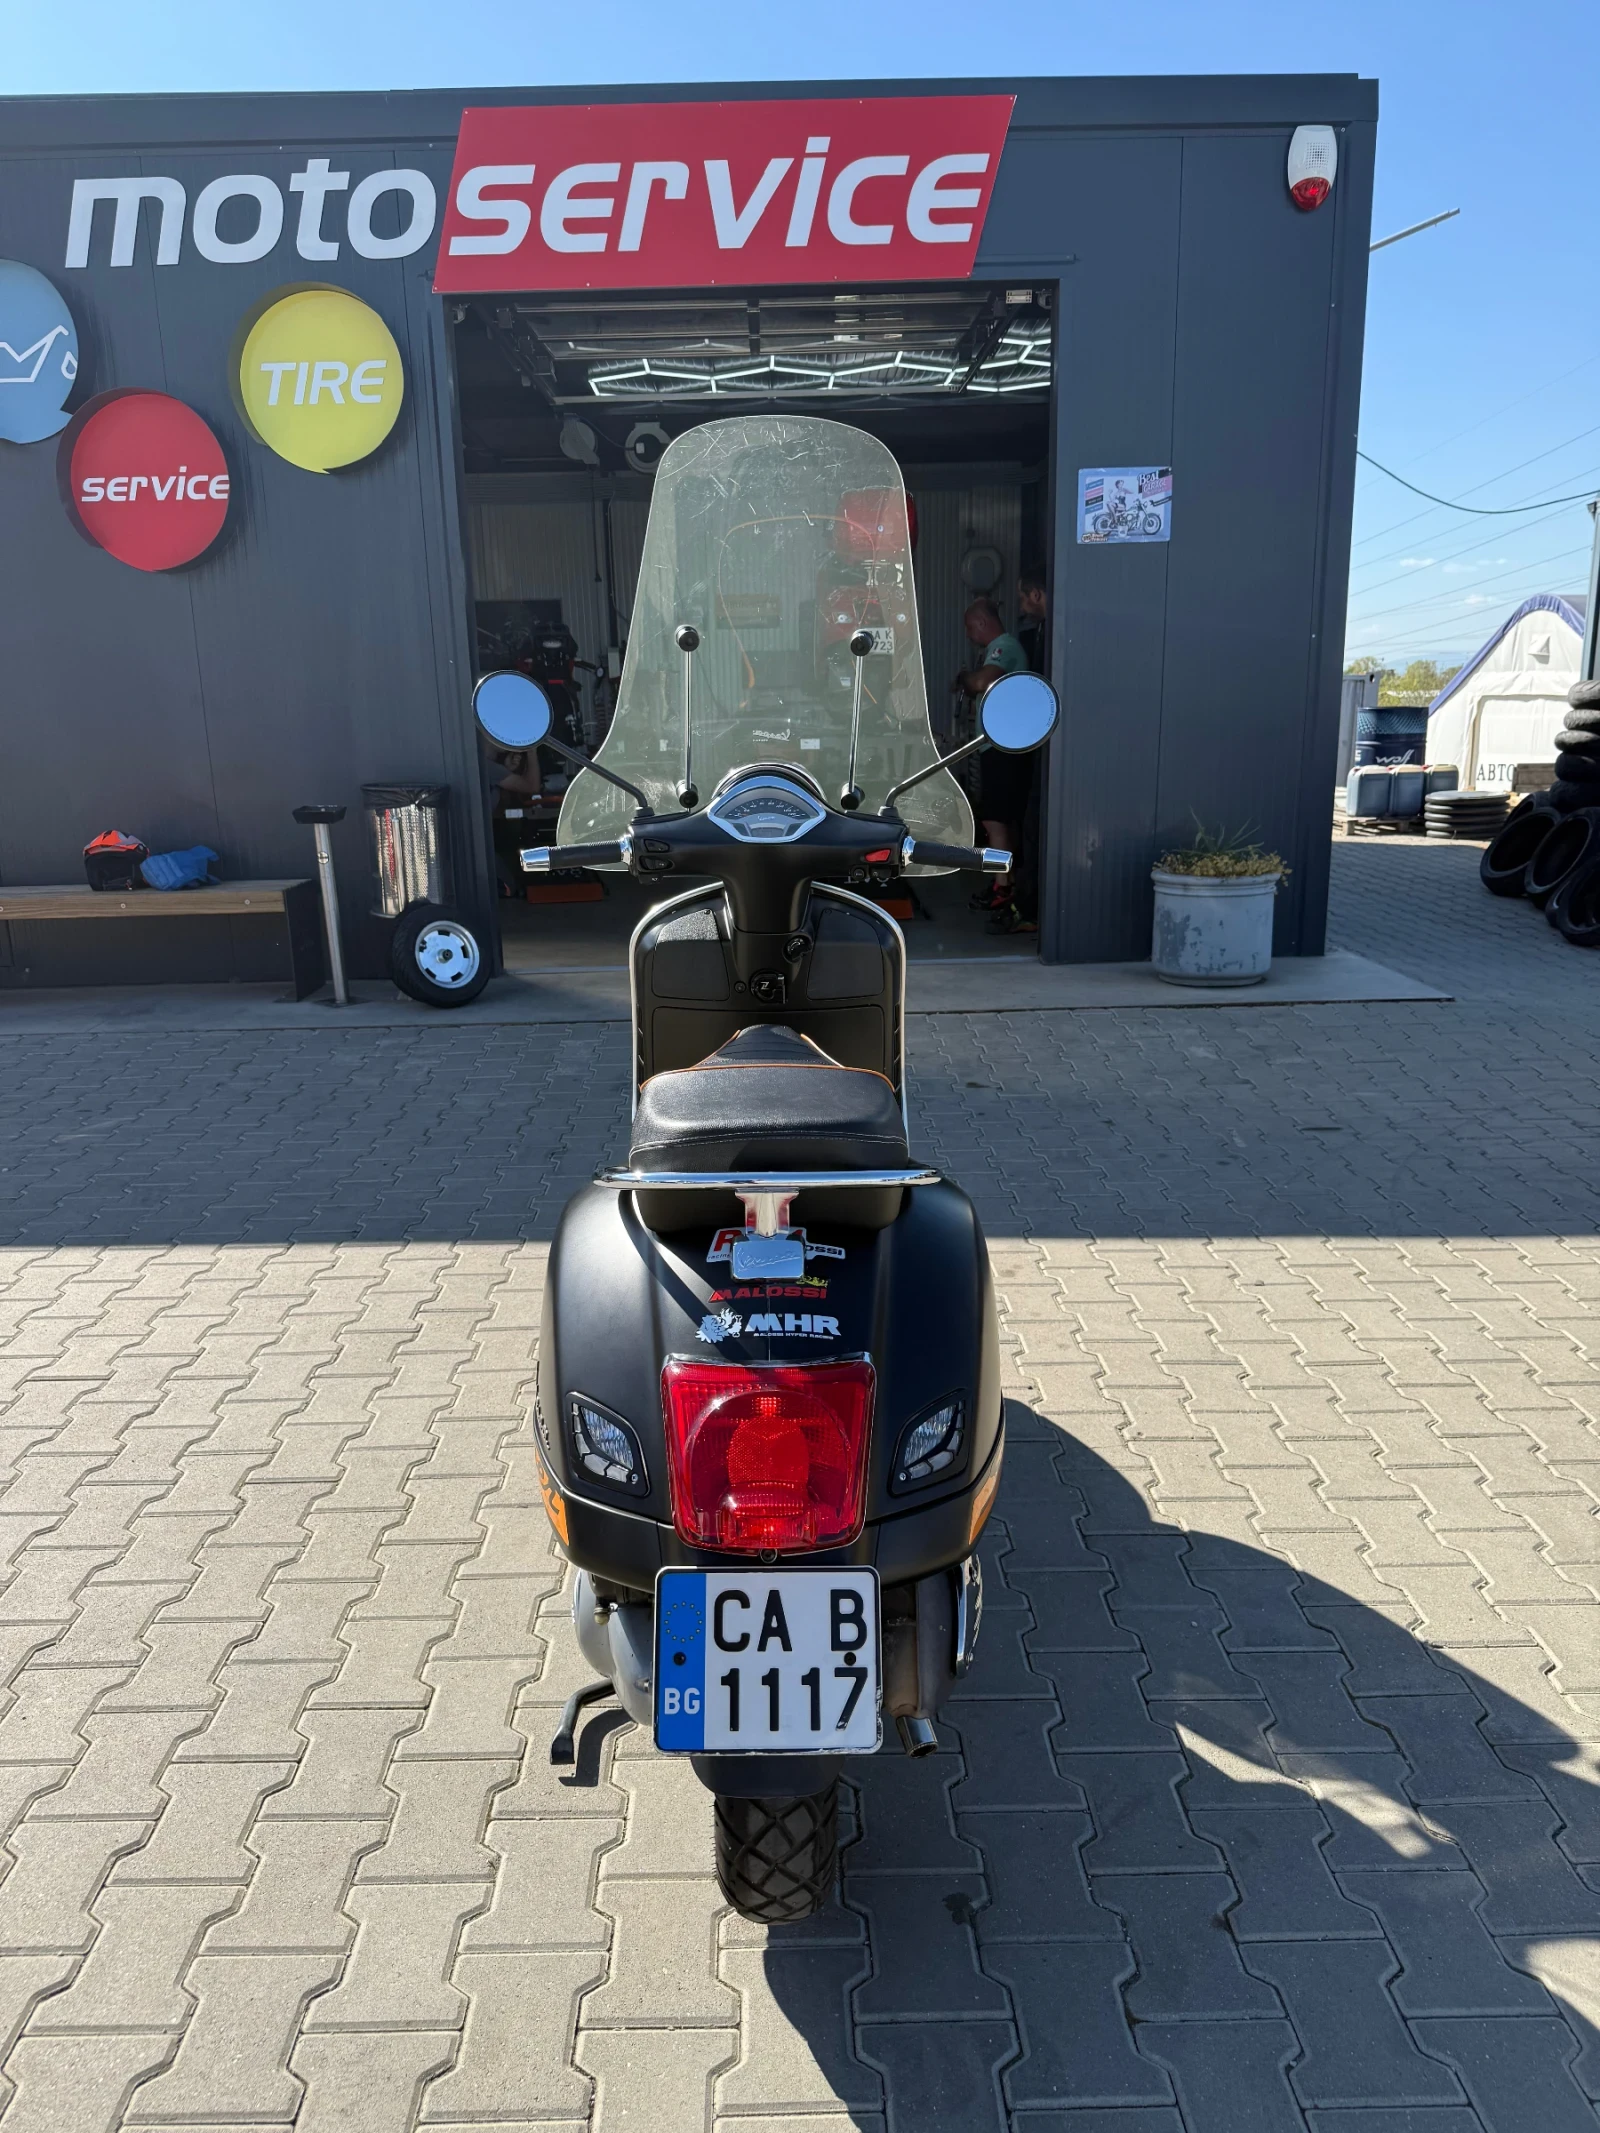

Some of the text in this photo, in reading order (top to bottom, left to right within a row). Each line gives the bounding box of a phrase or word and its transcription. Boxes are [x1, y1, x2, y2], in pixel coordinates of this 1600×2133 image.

[65, 158, 437, 269] moto
[260, 359, 388, 407] TIRE
[708, 1286, 828, 1303] MALOSSI
[713, 1588, 868, 1652] CA B
[664, 1687, 701, 1715] BG
[720, 1666, 869, 1732] 1117
